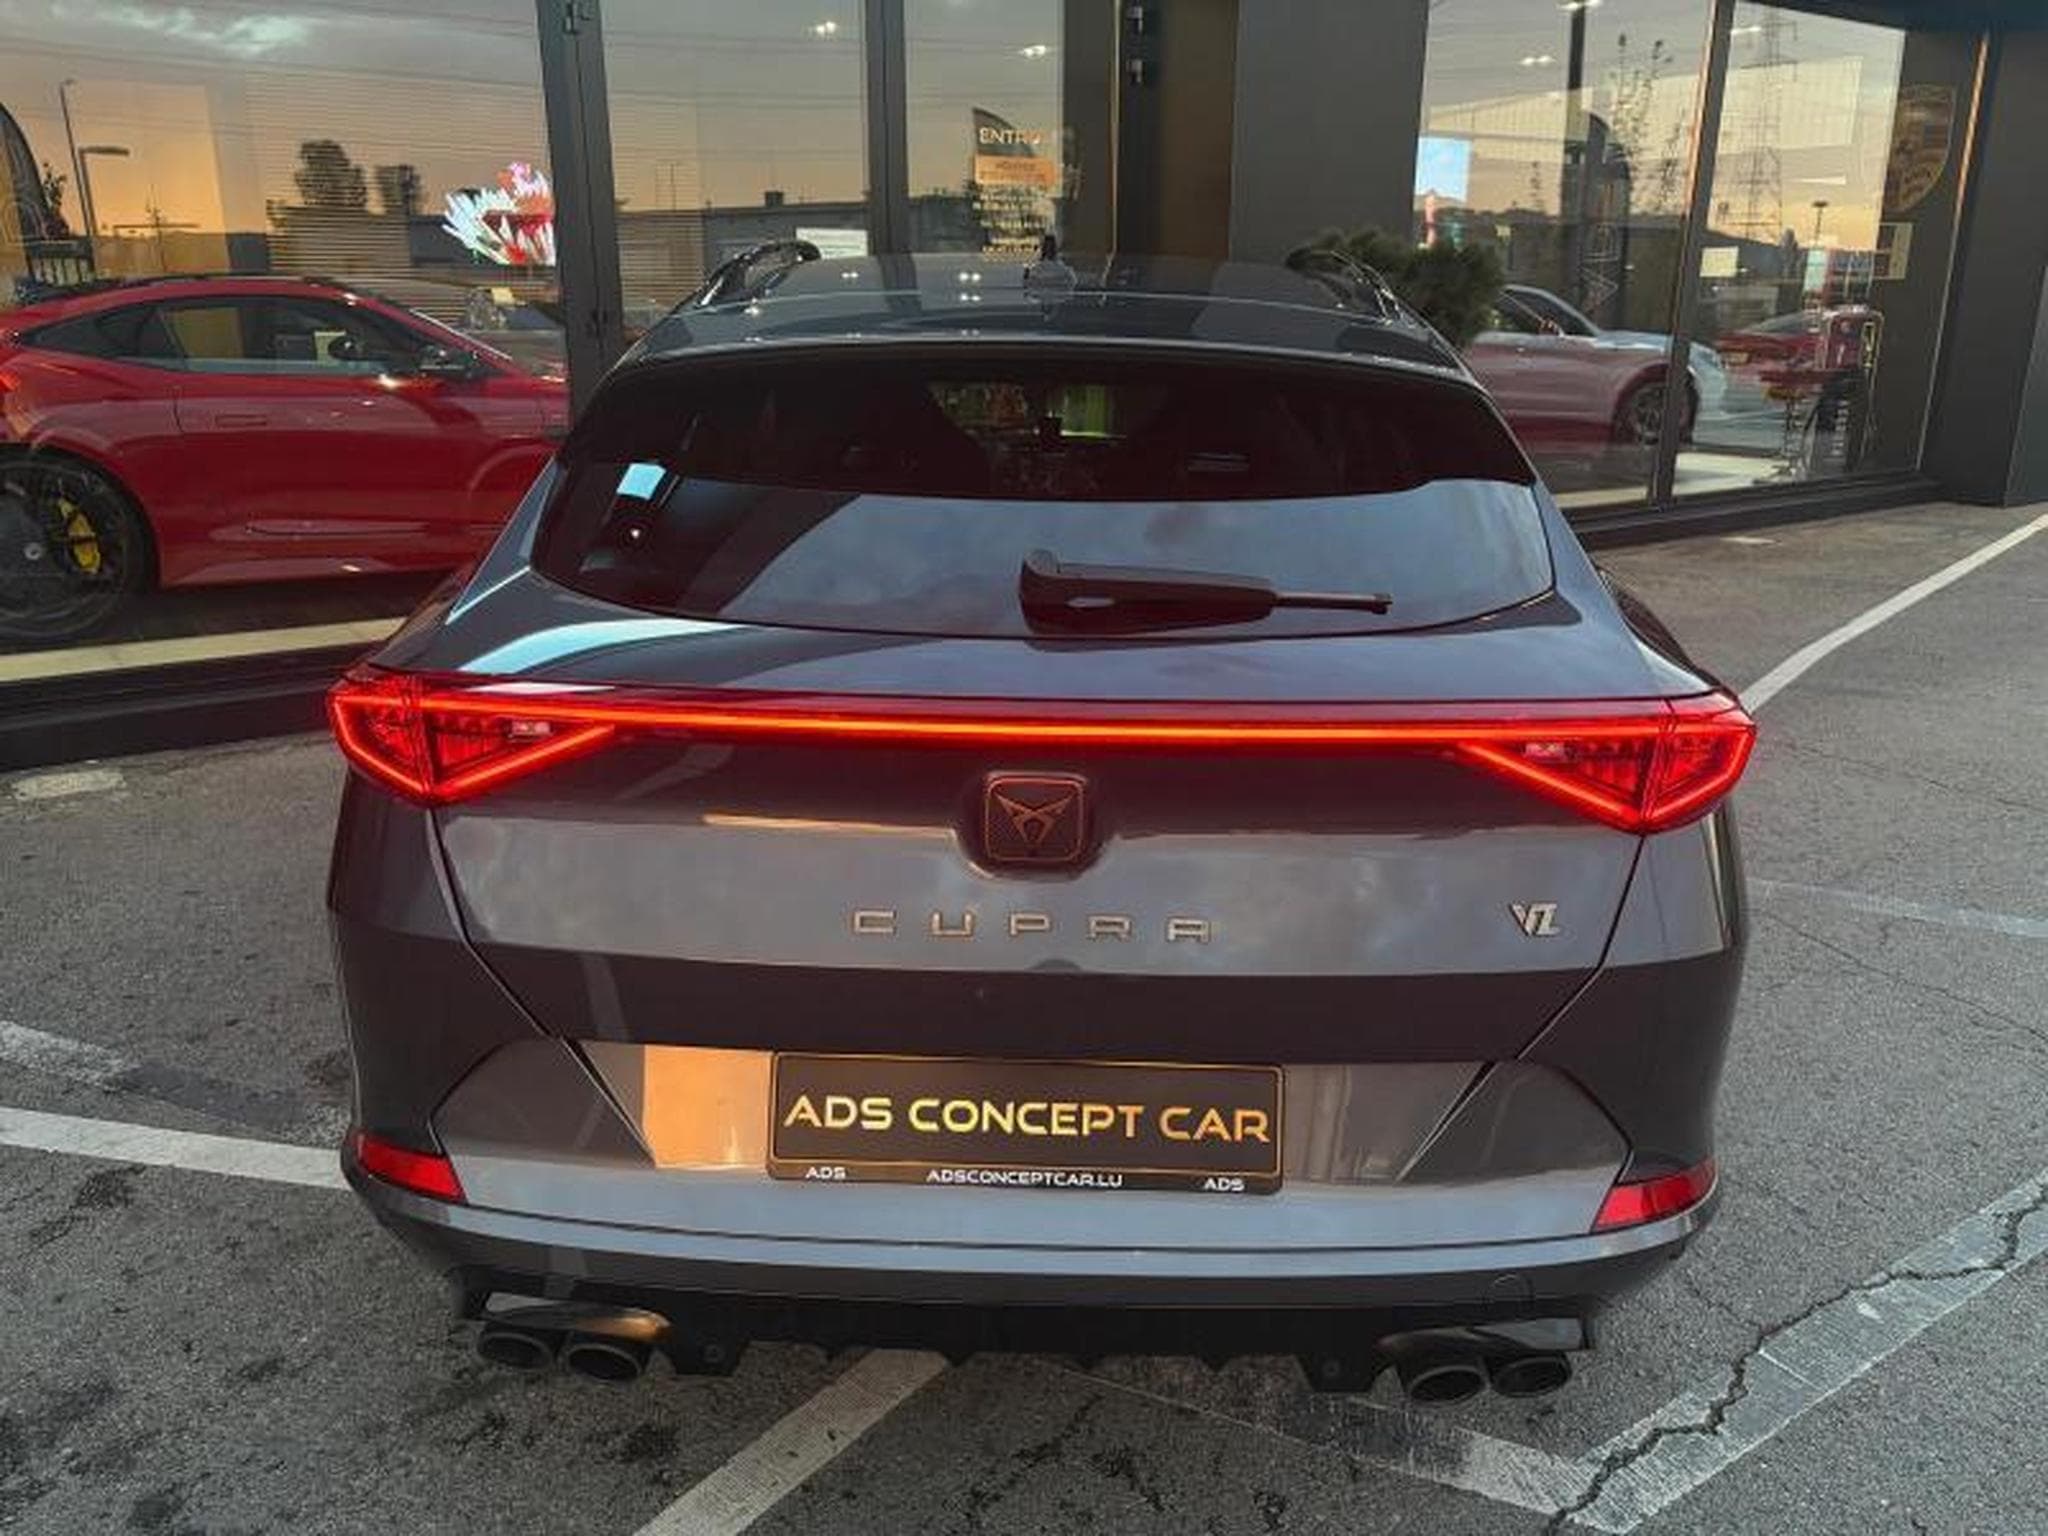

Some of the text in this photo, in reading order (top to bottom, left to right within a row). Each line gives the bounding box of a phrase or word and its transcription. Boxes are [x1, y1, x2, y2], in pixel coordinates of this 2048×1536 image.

[852, 909, 1213, 943] CUPRA
[1508, 902, 1561, 937] VZ
[783, 1094, 1270, 1143] ADS CONCEPT CAR
[805, 1166, 846, 1180] ADS
[926, 1168, 1123, 1188] ADSCONCEPTCAR.LU
[1204, 1177, 1246, 1192] ADS
